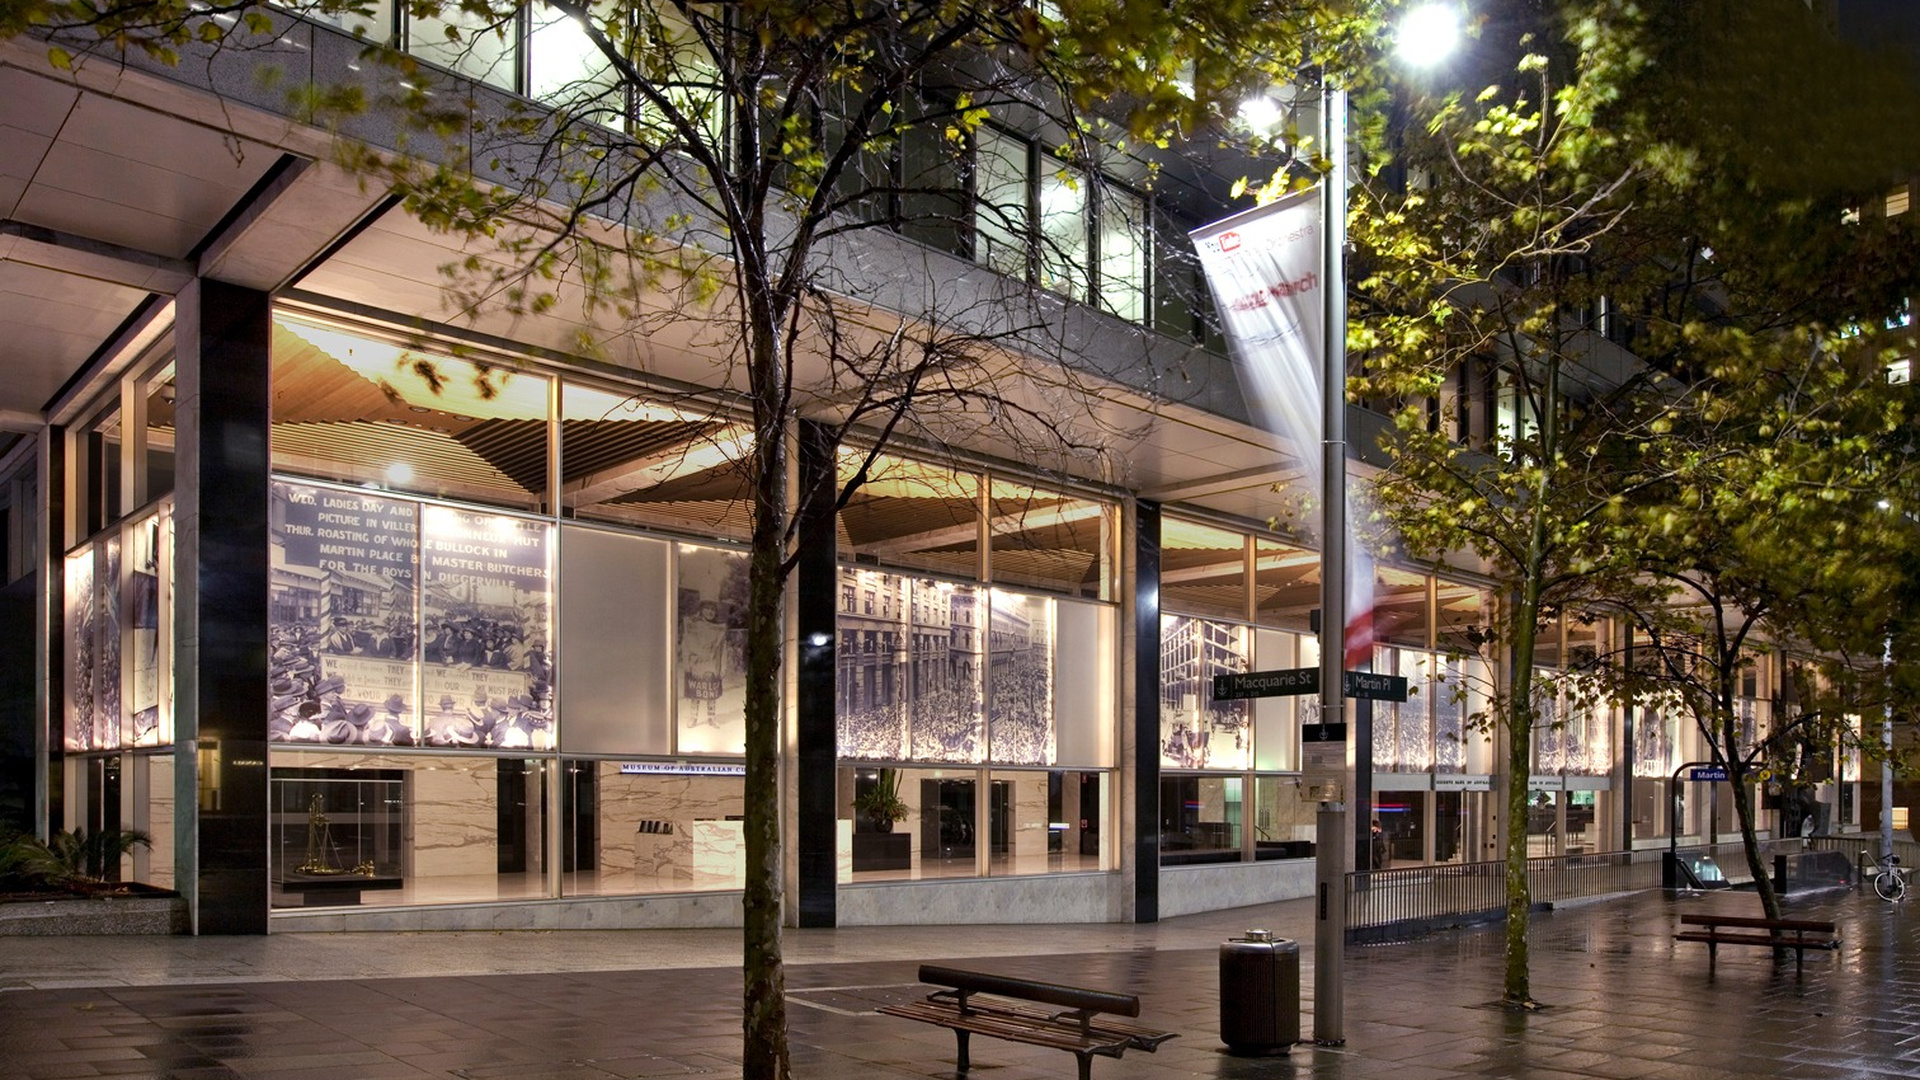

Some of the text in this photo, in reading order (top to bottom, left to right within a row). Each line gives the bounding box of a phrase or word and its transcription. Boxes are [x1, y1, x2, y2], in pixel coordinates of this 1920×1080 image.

[288, 493, 317, 506] WED.
[323, 498, 359, 511] LADIES
[362, 502, 385, 513] DAY
[390, 506, 413, 517] AND
[318, 512, 360, 526] PICTURE
[366, 518, 378, 528] IN
[382, 520, 418, 533] VILLER
[285, 524, 508, 559] THUR. ROASTING OF WHOE BULLOCK IN
[319, 544, 365, 558] MARTIN
[369, 550, 404, 562] PLACE
[432, 556, 484, 571] MASTER
[487, 562, 551, 579] BUTCHERS
[319, 559, 347, 572] FOR
[353, 563, 377, 575] THE
[382, 567, 412, 579] BOYS
[438, 572, 516, 588] DIGGERVILLE
[325, 658, 338, 669] WE
[387, 664, 405, 675] THEY
[436, 668, 447, 678] WE
[472, 672, 489, 682] THEY
[384, 676, 402, 687] THEY
[444, 681, 460, 691] OUR
[488, 684, 506, 695] MUST
[1234, 671, 1312, 691] Macquarie St
[1355, 675, 1391, 691] Martin Pl
[679, 765, 733, 773] AUSTRALIAN
[1697, 771, 1726, 779] Martin
